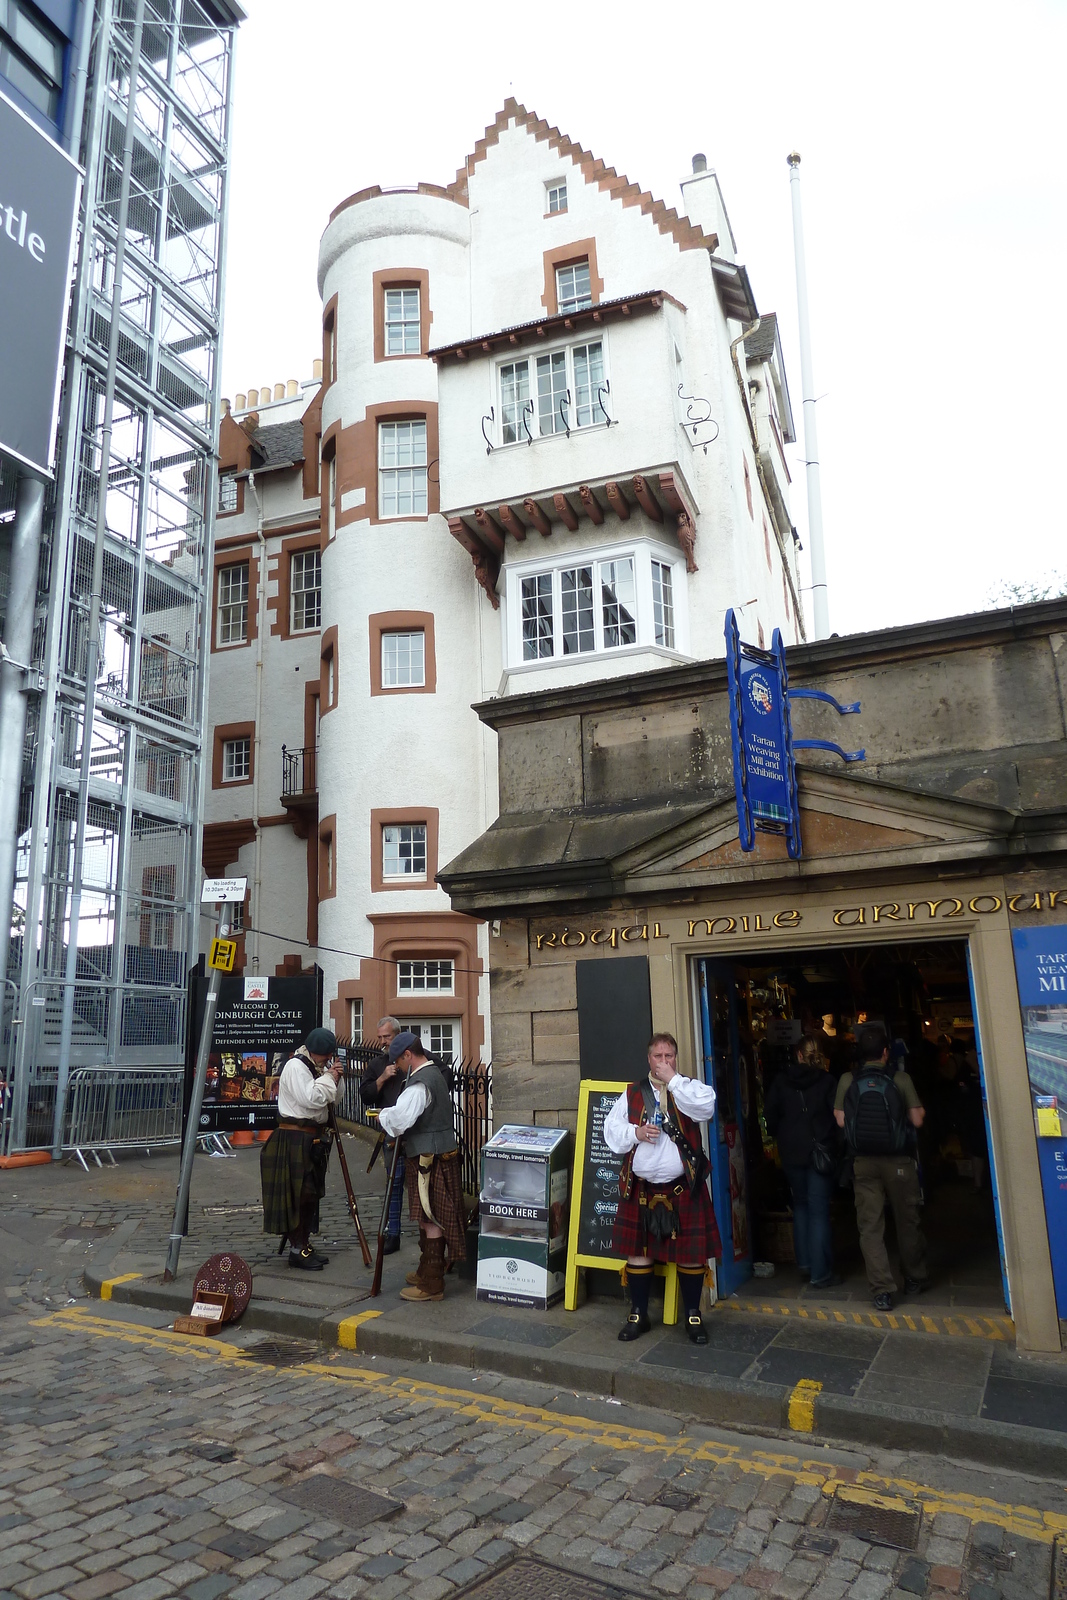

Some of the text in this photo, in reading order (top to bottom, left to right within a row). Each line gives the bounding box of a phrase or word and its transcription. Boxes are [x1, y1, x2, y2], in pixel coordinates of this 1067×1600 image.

[0, 203, 46, 263] tle
[752, 734, 776, 748] Tartan
[748, 743, 781, 760] Weaving
[751, 754, 779, 770] Mill and
[748, 765, 784, 782] Exhibition
[1036, 953, 1067, 964] TAR
[1037, 965, 1067, 974] WEA
[490, 1205, 538, 1218] BOOK HERE
